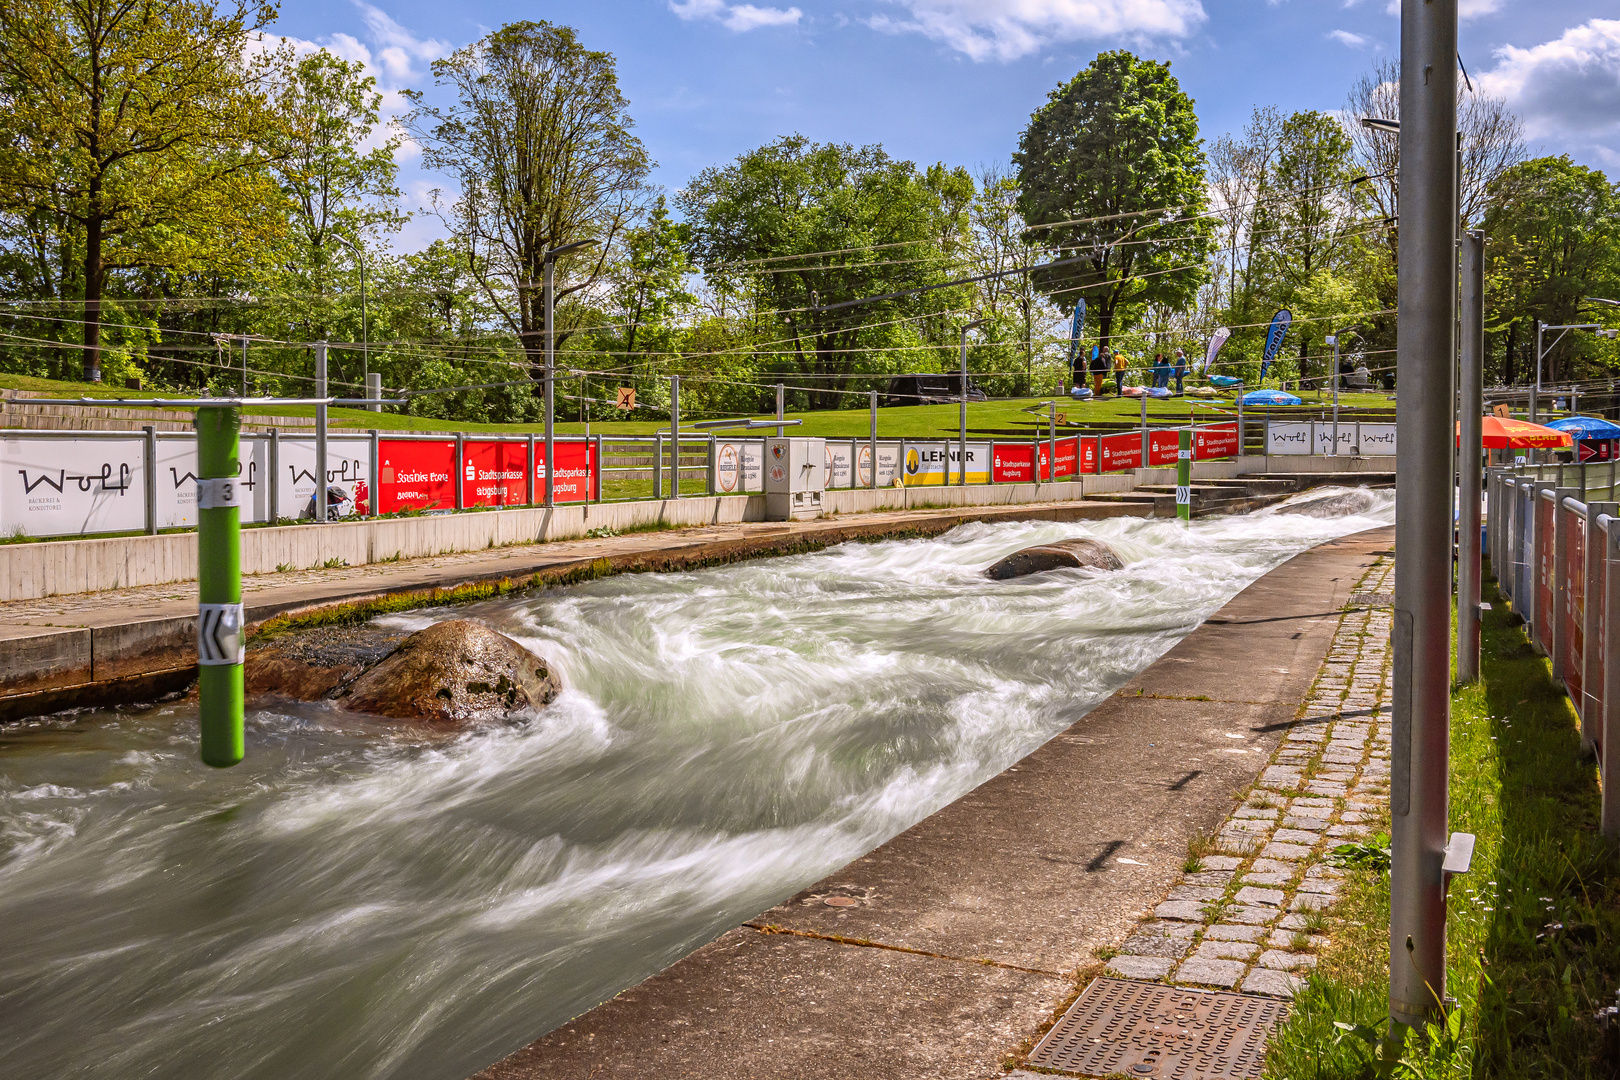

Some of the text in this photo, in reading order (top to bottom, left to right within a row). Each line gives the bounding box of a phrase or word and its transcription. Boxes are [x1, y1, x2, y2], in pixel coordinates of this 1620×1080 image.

[1498, 407, 1504, 417] 1
[1057, 413, 1064, 423] 2
[1206, 437, 1237, 446] Stadtsparkasse
[1272, 431, 1307, 444] Wolf
[1363, 432, 1395, 444] Wolf
[1206, 446, 1227, 455] Augsburg
[1160, 452, 1178, 460] Augsbur
[1002, 461, 1031, 470] Stadtsparkasse
[1112, 458, 1132, 466] Augsburg
[478, 469, 523, 482] Stadtsparkasse
[552, 467, 592, 479] tadtsparkase
[1002, 470, 1021, 478] Augsburg
[18, 462, 129, 496] Wolf
[222, 484, 233, 501] 3
[552, 482, 577, 494] ugsburg
